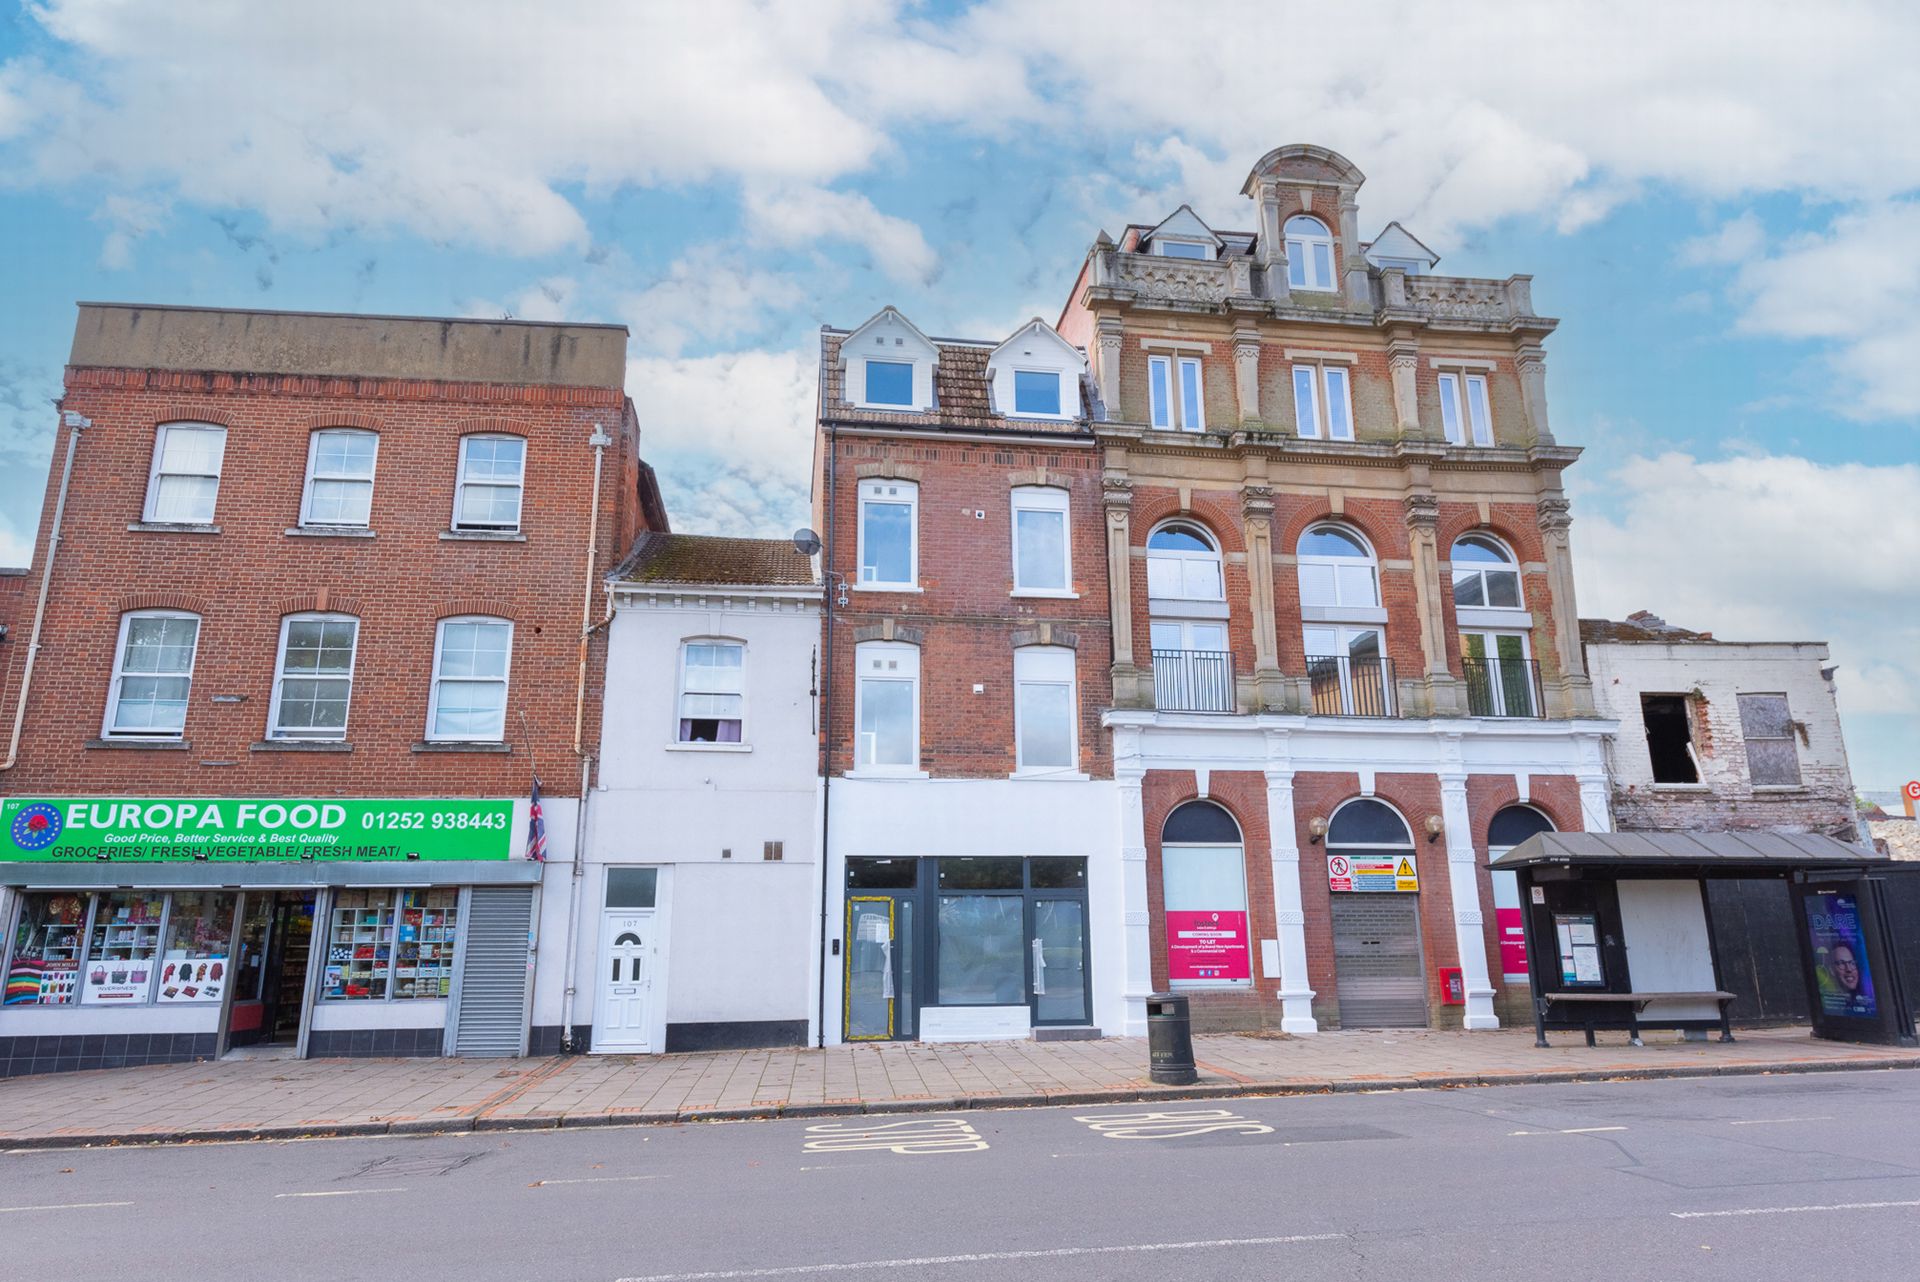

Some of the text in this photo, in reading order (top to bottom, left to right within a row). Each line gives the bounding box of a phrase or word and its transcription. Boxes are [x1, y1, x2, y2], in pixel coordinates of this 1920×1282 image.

[65, 804, 347, 829] EUROPA FOOD
[361, 812, 506, 830] 01252 938443
[104, 833, 339, 845] Good Price, Better Service & Best Quality
[52, 846, 400, 858] GROCERIES/ FRESH VEGETABLE/ FRESH MEAT/
[623, 920, 637, 928] 107
[1812, 914, 1857, 929] DARE
[1072, 1109, 1275, 1139] BUS
[801, 1119, 990, 1154] STOP
